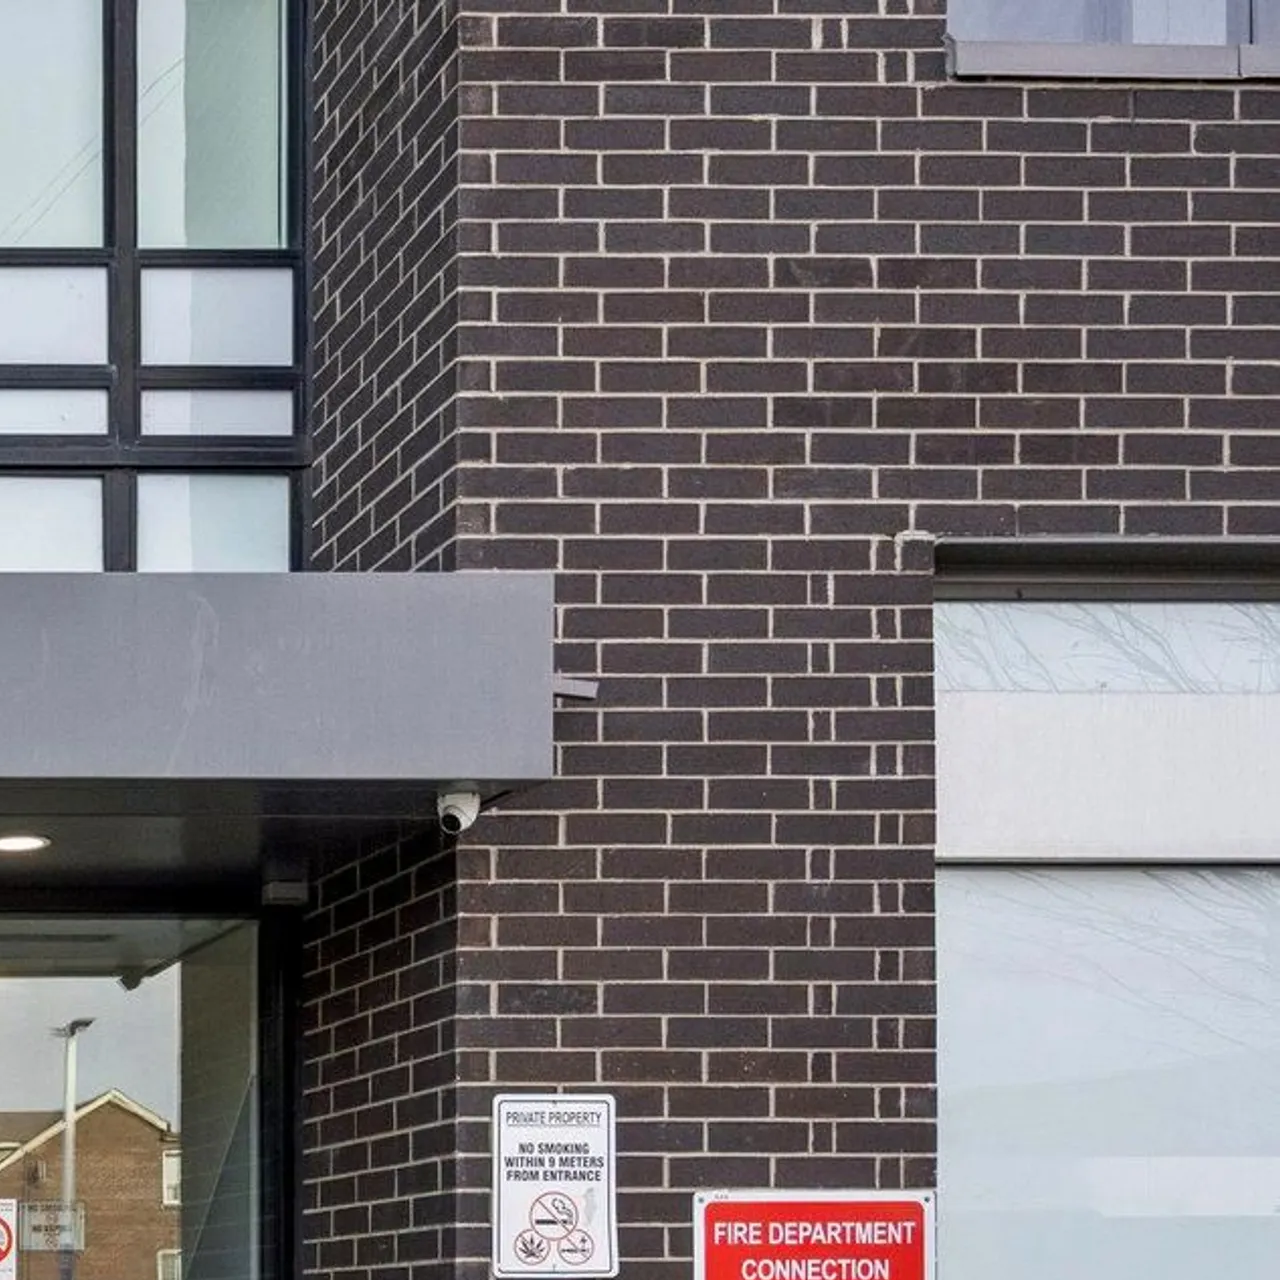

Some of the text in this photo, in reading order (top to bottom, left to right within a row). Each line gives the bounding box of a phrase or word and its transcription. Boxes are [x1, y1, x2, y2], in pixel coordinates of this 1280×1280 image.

[506, 1111, 602, 1124] PRIVATE PROPERTY
[518, 1143, 590, 1154] NO SMOKING
[504, 1156, 605, 1168] WITHIN 9 METERS
[506, 1170, 602, 1181] FROM ENTRANCE
[713, 1221, 917, 1245] FIRE DEPARTMENT
